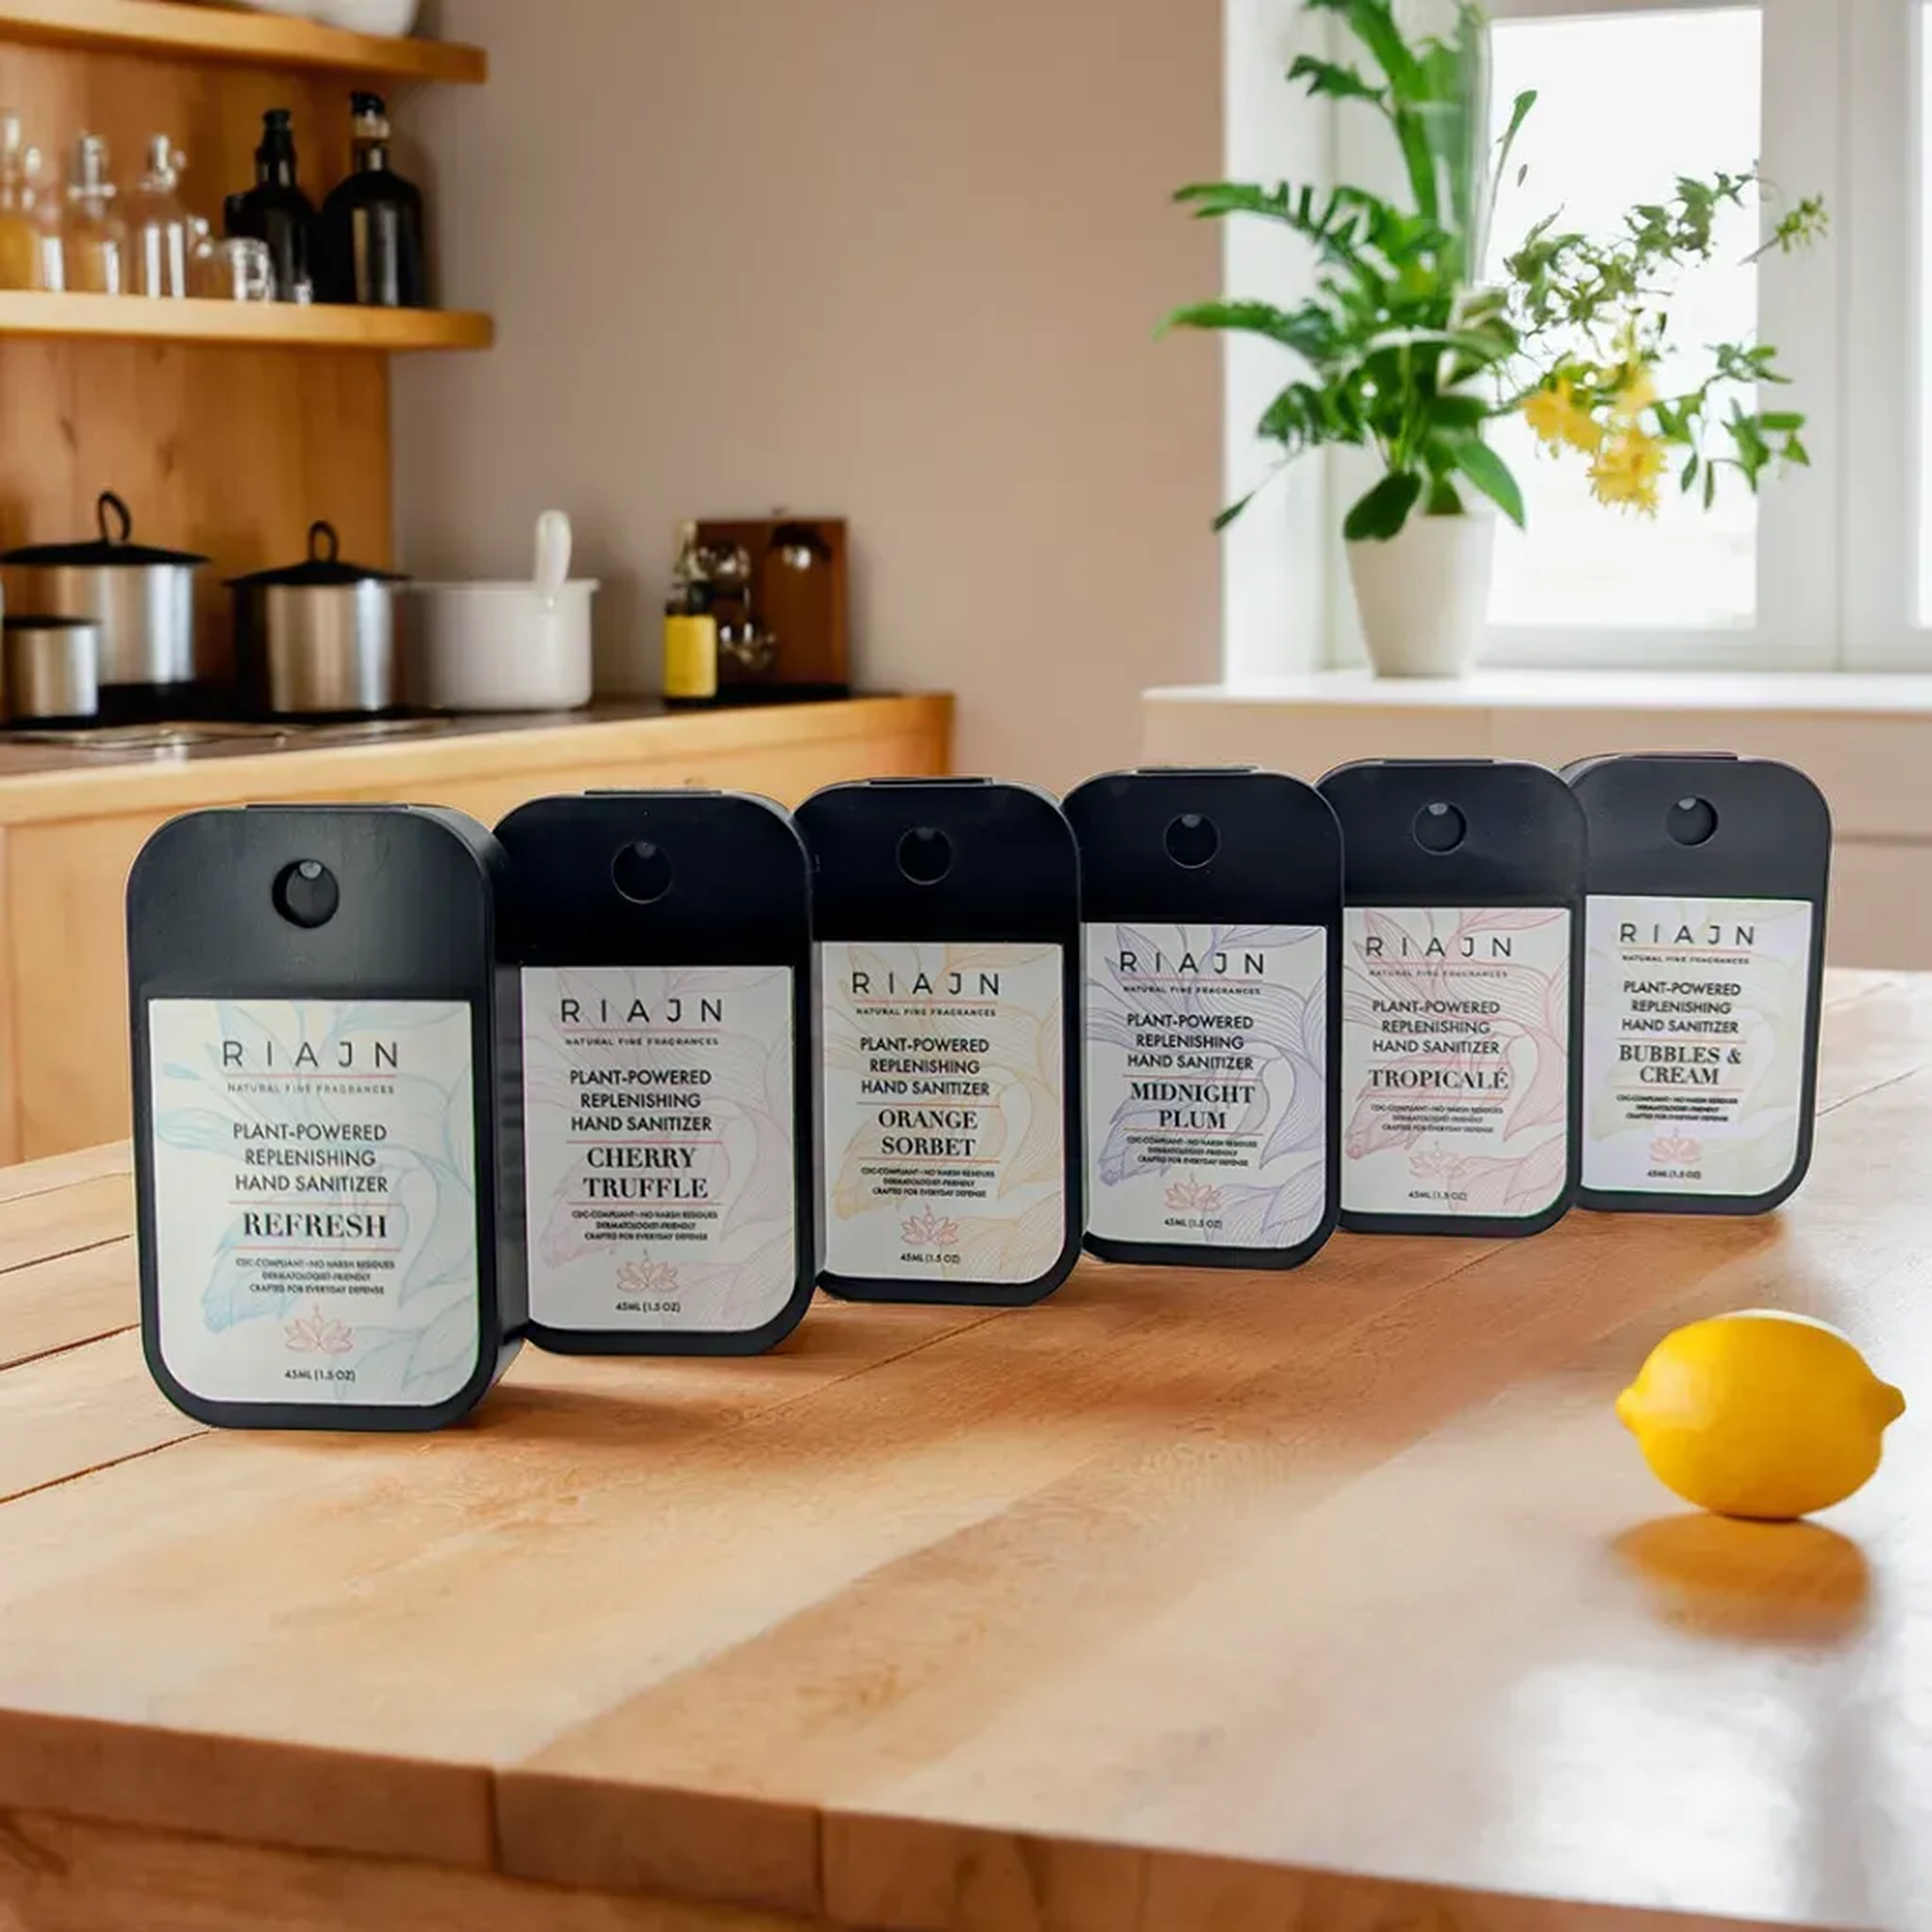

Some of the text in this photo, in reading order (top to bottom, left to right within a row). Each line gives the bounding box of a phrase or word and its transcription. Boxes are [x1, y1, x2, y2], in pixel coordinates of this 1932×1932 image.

[1621, 923, 1754, 945] RIAJN
[1366, 937, 1511, 957] RIAJN
[1120, 952, 1264, 974] RIAJN
[852, 972, 999, 995] RIAJN
[1196, 987, 1260, 995] FRAGRANCES
[1624, 981, 1741, 996] PLANT-POWERED
[561, 999, 722, 1023] RIAJN
[931, 1008, 996, 1017] FRAGRANCES
[1373, 1000, 1500, 1014] PLANT-POWERED
[1631, 999, 1732, 1014] REPLENISHING
[1127, 1013, 1254, 1029] PLANT-POWERED
[1382, 1020, 1491, 1034] REPLENISHING
[1622, 1019, 1739, 1033] HAND SANITIZER
[566, 1038, 719, 1046] NATURAL FINE FRAGRANCES
[860, 1038, 990, 1053] PLANT-POWERED
[1136, 1034, 1244, 1050] REPLENISHING
[1373, 1040, 1500, 1054] HAND SANITIZER
[223, 1041, 398, 1069] RIAJN
[1619, 1044, 1741, 1064] BUBBLES &
[870, 1059, 980, 1074] REPLENISHING
[1127, 1055, 1254, 1070] HAND SANITIZER
[570, 1070, 711, 1085] PLANT-POWERED
[1369, 1067, 1508, 1090] TROPICALÉ
[1640, 1066, 1720, 1085] CREAM
[227, 1084, 394, 1094] NATURAL FINE FRAGRANCES
[862, 1081, 990, 1096] HAND SANITIZER
[1131, 1082, 1256, 1104] MIDNIGHT
[581, 1093, 701, 1108] REPLENISHING
[572, 1116, 712, 1131] HAND SANITIZER
[878, 1109, 978, 1130] ORANGE
[1159, 1109, 1225, 1129] PLUM
[233, 1123, 387, 1141] PLANT-POWERED
[881, 1137, 976, 1157] SORBET
[245, 1149, 375, 1166] REPLENISHING
[587, 1146, 696, 1169] CHERRY
[235, 1175, 389, 1192] HAND SANITIZER
[582, 1177, 708, 1198] TRUFFLE
[1408, 1191, 1431, 1199] 45ML
[243, 1212, 388, 1238] REFRESH
[1164, 1218, 1188, 1226] 45ML
[901, 1254, 959, 1264] 45ML (1.5 OZ)
[288, 1285, 304, 1293] FOR
[616, 1302, 680, 1312] 45ML (1.5 OZ)
[285, 1370, 356, 1382] 45ML (1.5 OZ)
